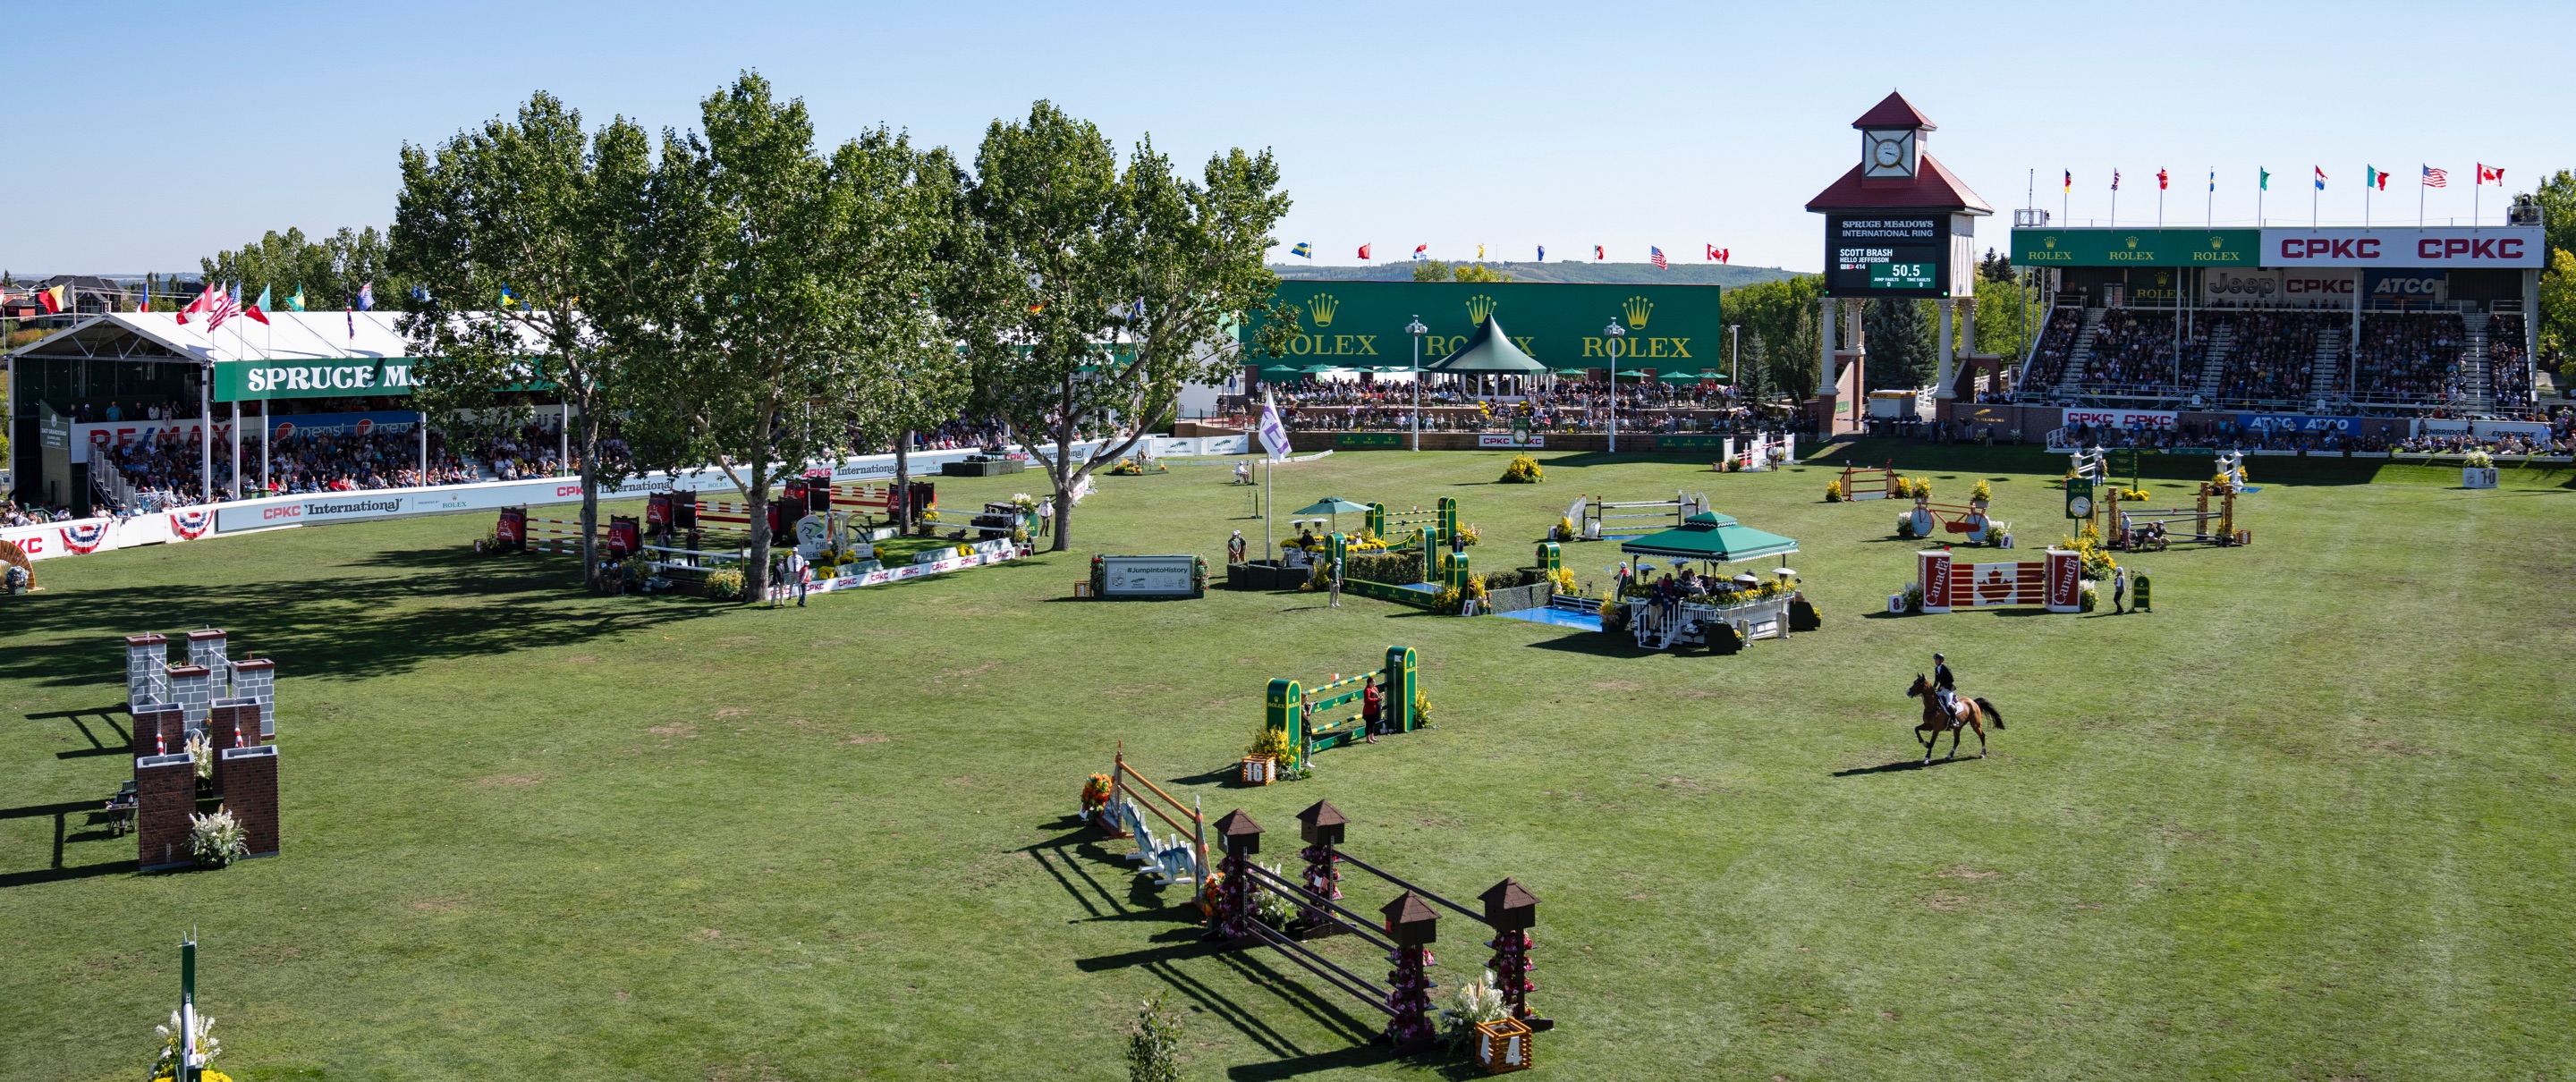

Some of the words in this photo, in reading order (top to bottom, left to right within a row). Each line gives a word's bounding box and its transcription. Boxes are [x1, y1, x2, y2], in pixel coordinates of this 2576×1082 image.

[2281, 239, 2381, 258] CPKC
[2418, 239, 2524, 258] CPKC
[2028, 252, 2072, 260] ROLEX
[2109, 252, 2154, 260] ROLEX
[2193, 252, 2240, 261] ROLEX
[1893, 265, 1920, 276] 50.5
[2209, 273, 2276, 297] Jeep
[2286, 279, 2354, 293] CPKC
[2374, 278, 2436, 293] ATCO
[2137, 290, 2185, 299] ROLEX
[1267, 334, 1379, 355] OLEX
[1425, 335, 1537, 357] ROX
[1582, 336, 1692, 358] ROLEX
[248, 365, 376, 392] SPRUCE
[2068, 413, 2114, 423] CPKC
[2125, 415, 2172, 426] CPKC
[90, 425, 231, 450] RE/MAX
[801, 468, 832, 478] CPKC
[2481, 470, 2496, 484] 10
[557, 486, 584, 496] CPK
[263, 506, 301, 520] CPKC
[2004, 537, 2009, 546] 6
[932, 562, 948, 571] CPKC
[961, 557, 977, 566] CPKC
[871, 573, 888, 581] CPKC
[902, 568, 919, 576] CPKC
[806, 583, 824, 591] CPKC
[839, 579, 857, 587] CPKC
[1926, 560, 1950, 605] Canada
[2054, 559, 2079, 604] Canada
[1080, 584, 1085, 596] 1
[1465, 603, 1471, 614] 5
[1893, 598, 1900, 610] 8
[1246, 763, 1262, 782] 16
[1506, 1036, 1522, 1065] 4
